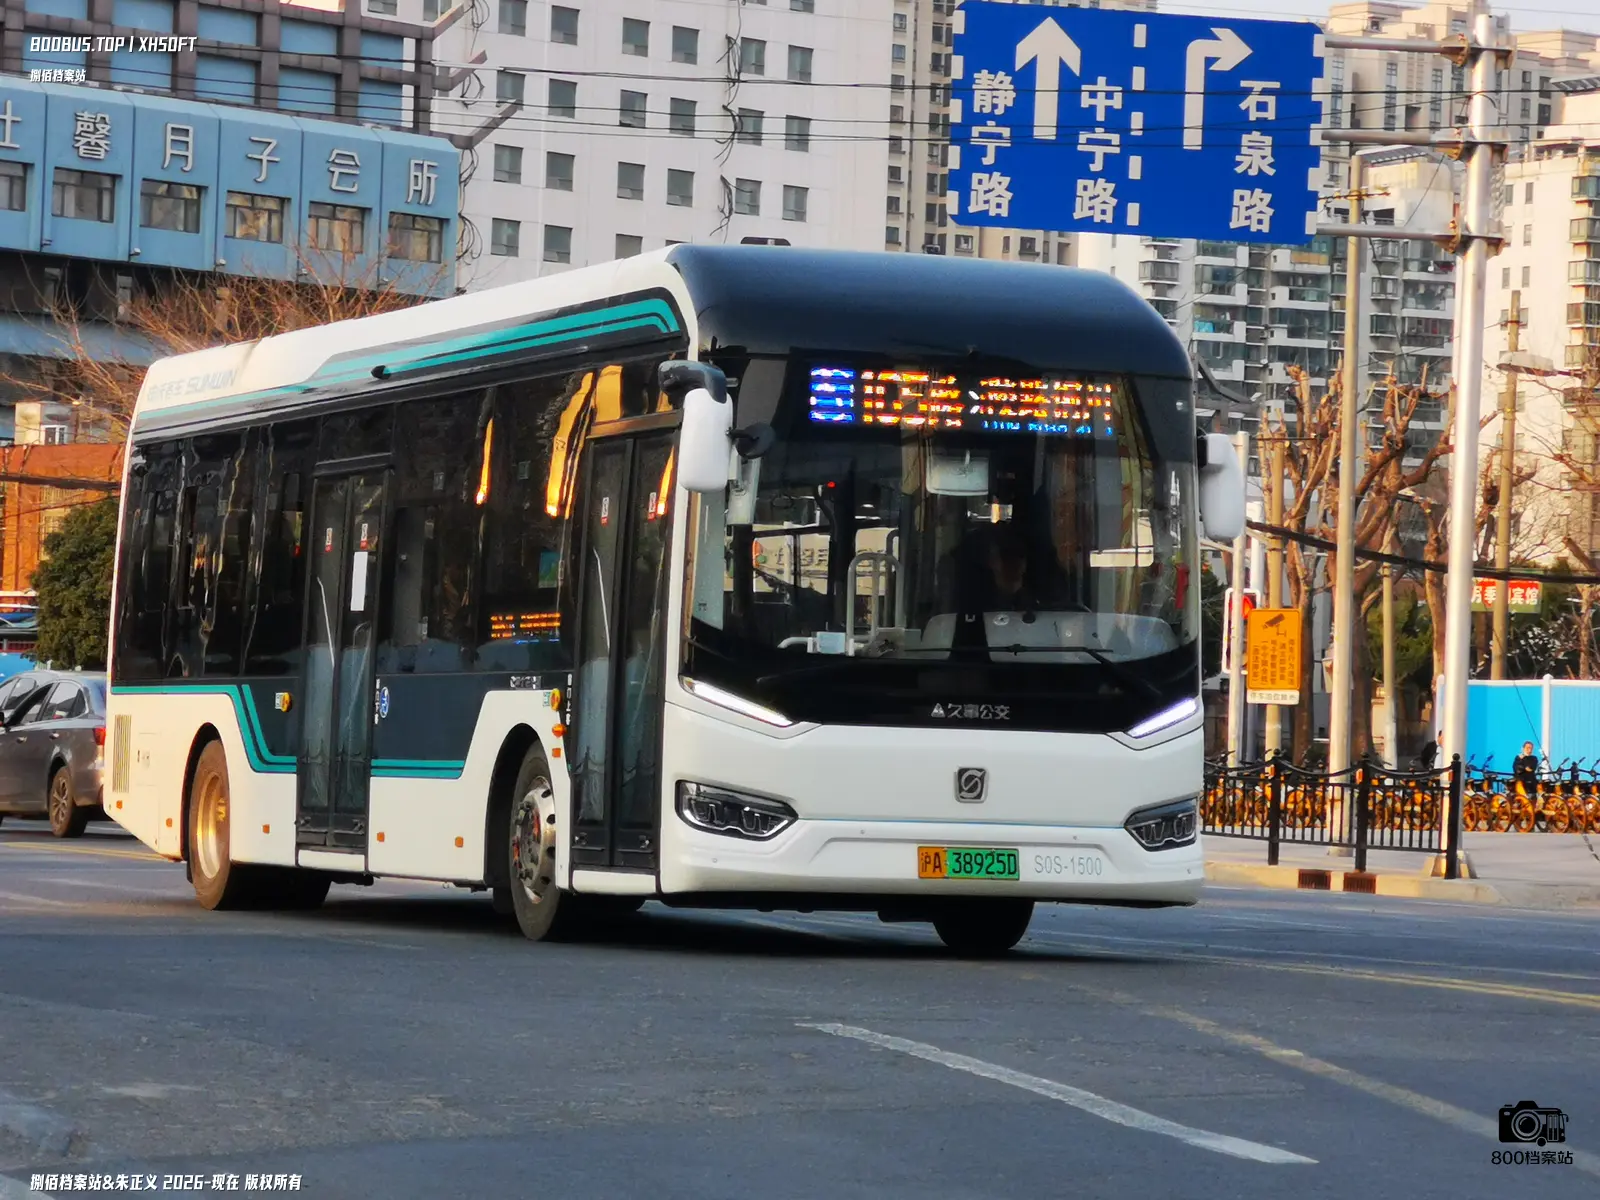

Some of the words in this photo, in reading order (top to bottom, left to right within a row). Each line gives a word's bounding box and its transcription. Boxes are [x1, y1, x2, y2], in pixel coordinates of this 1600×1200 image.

[968, 69, 1016, 217] 静宁路
[1073, 76, 1123, 224] 中宁路
[1230, 80, 1281, 233] 石泉路
[1471, 586, 1539, 605] 月季宾馆
